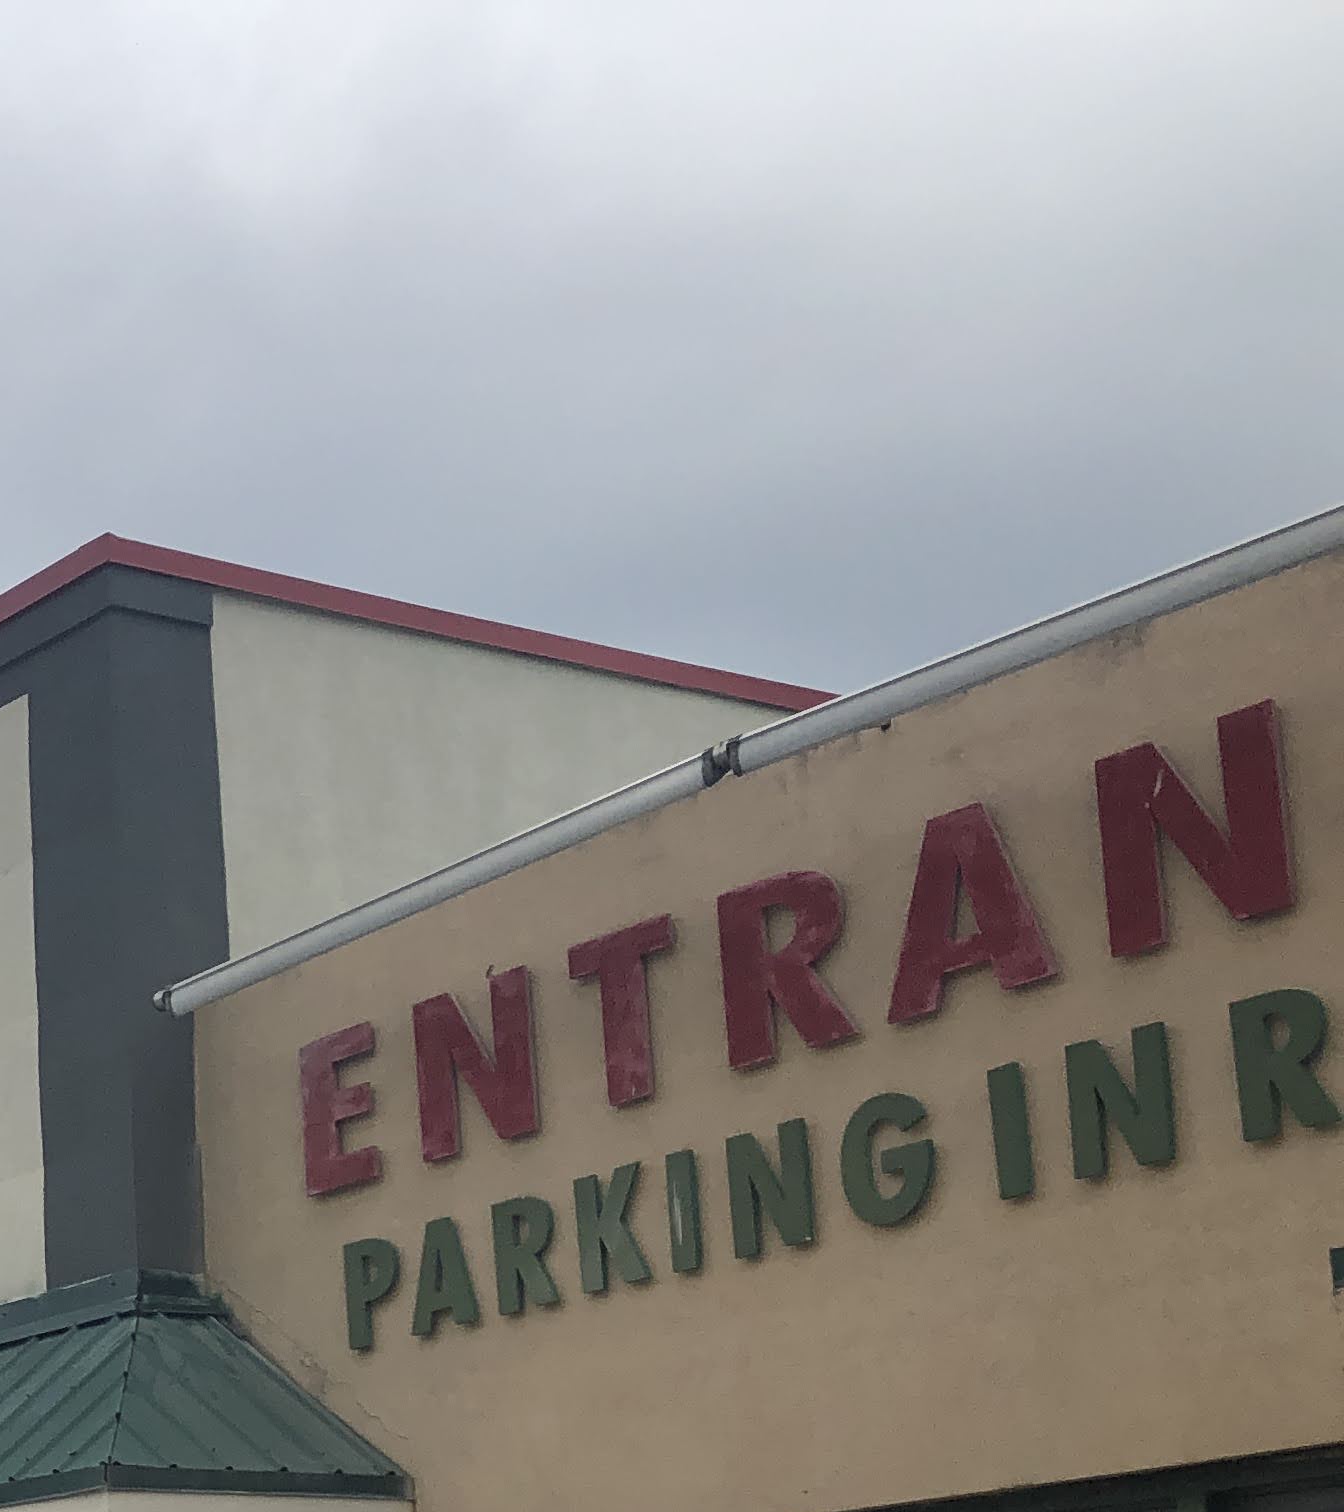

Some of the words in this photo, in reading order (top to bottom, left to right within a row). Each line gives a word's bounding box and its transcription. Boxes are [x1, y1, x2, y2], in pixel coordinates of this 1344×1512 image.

[298, 698, 1296, 1197] ENTRAN
[342, 1091, 936, 1351] PARKING
[987, 1020, 1177, 1200] IN
